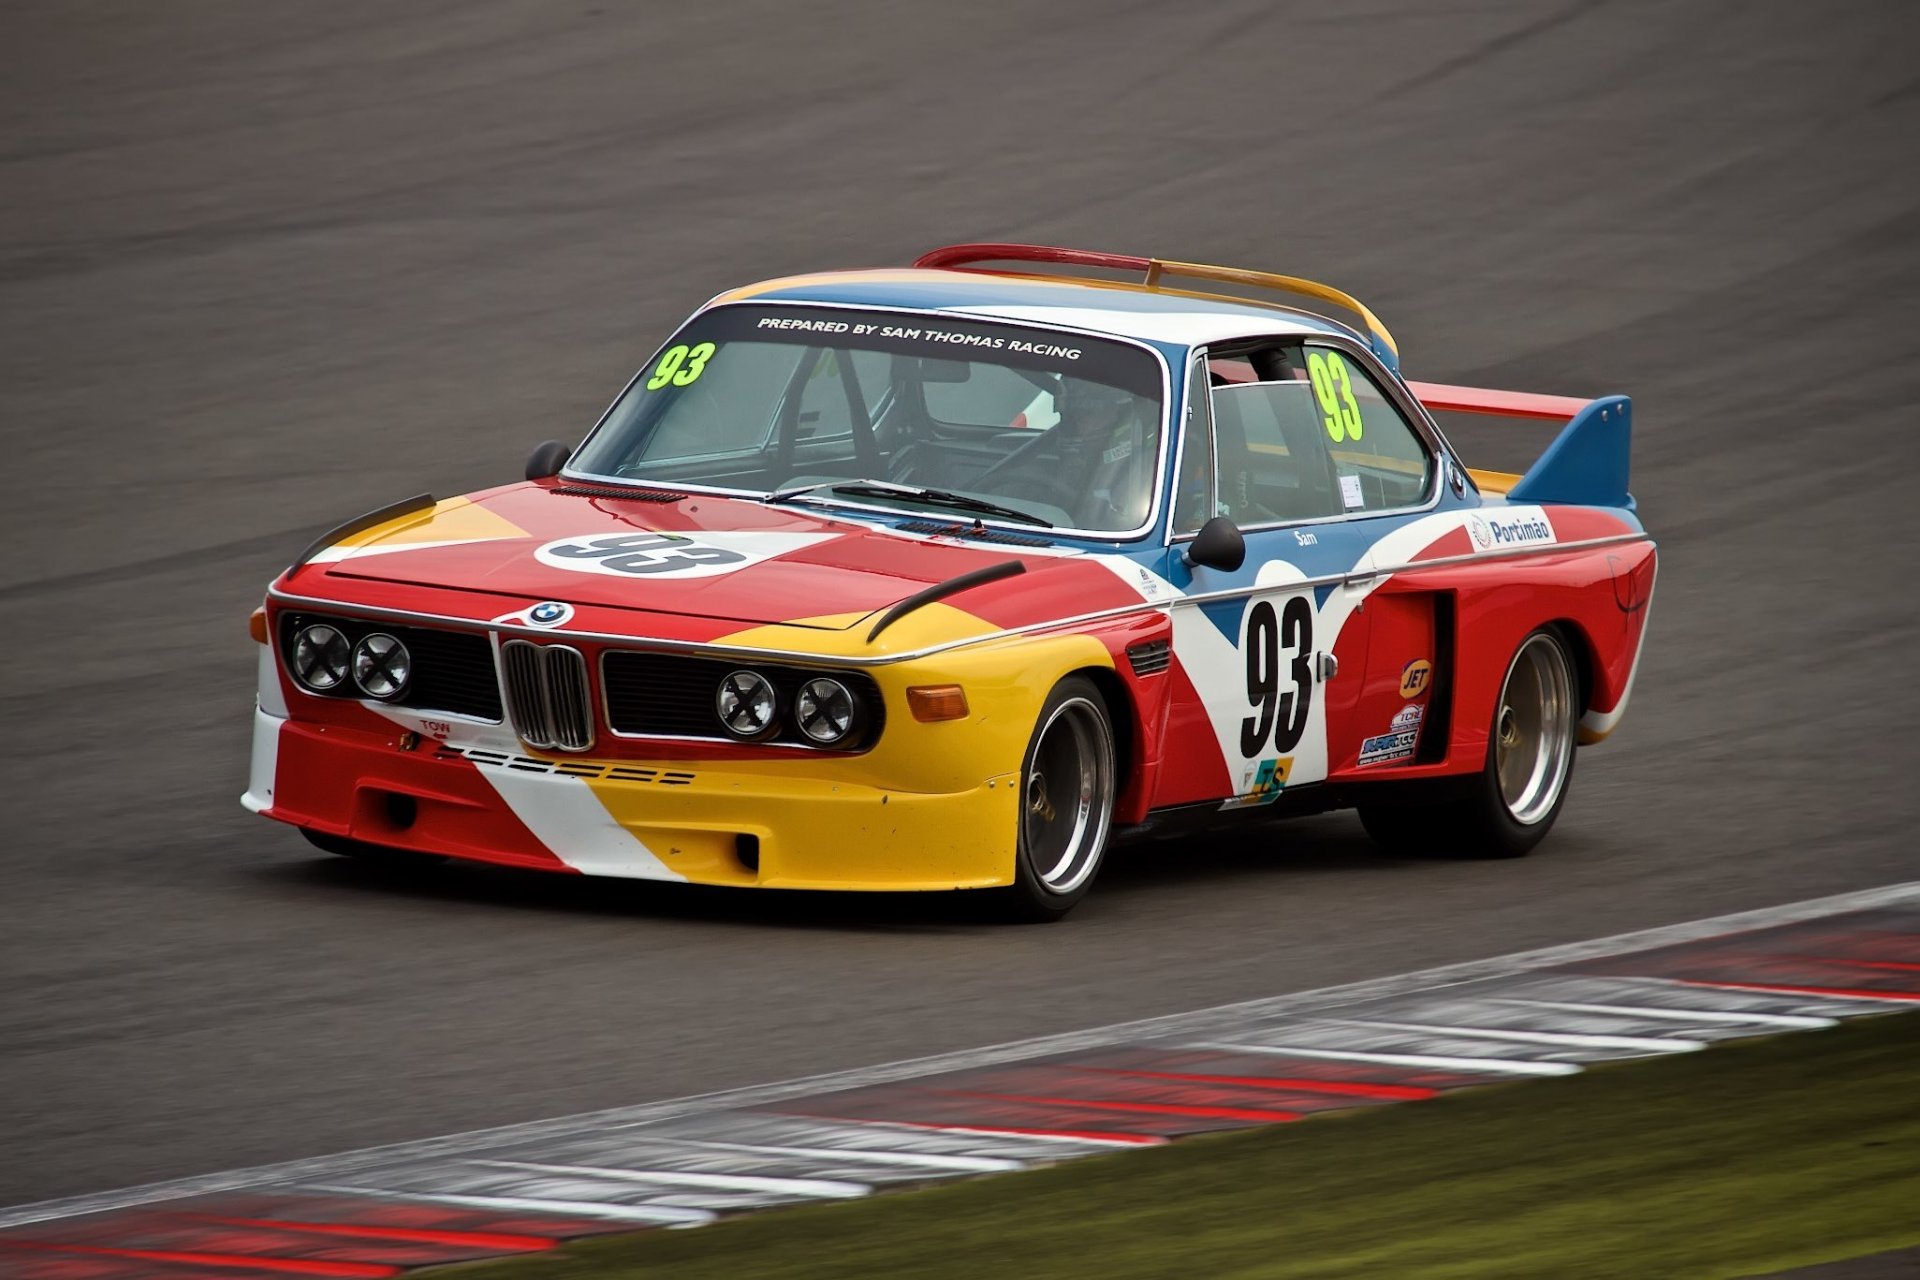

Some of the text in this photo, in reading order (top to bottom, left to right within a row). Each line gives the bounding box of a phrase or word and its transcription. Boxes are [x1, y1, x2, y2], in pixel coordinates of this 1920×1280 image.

[757, 317, 1082, 360] PREPARED BY SAM THOMAS RACING
[646, 342, 716, 391] 93
[1308, 351, 1363, 443] 93
[1294, 530, 1319, 547] Sam
[1489, 517, 1550, 543] Portimão
[549, 534, 747, 574] 93
[1240, 596, 1313, 759] 93
[1403, 668, 1428, 690] JET
[419, 719, 451, 733] TOW
